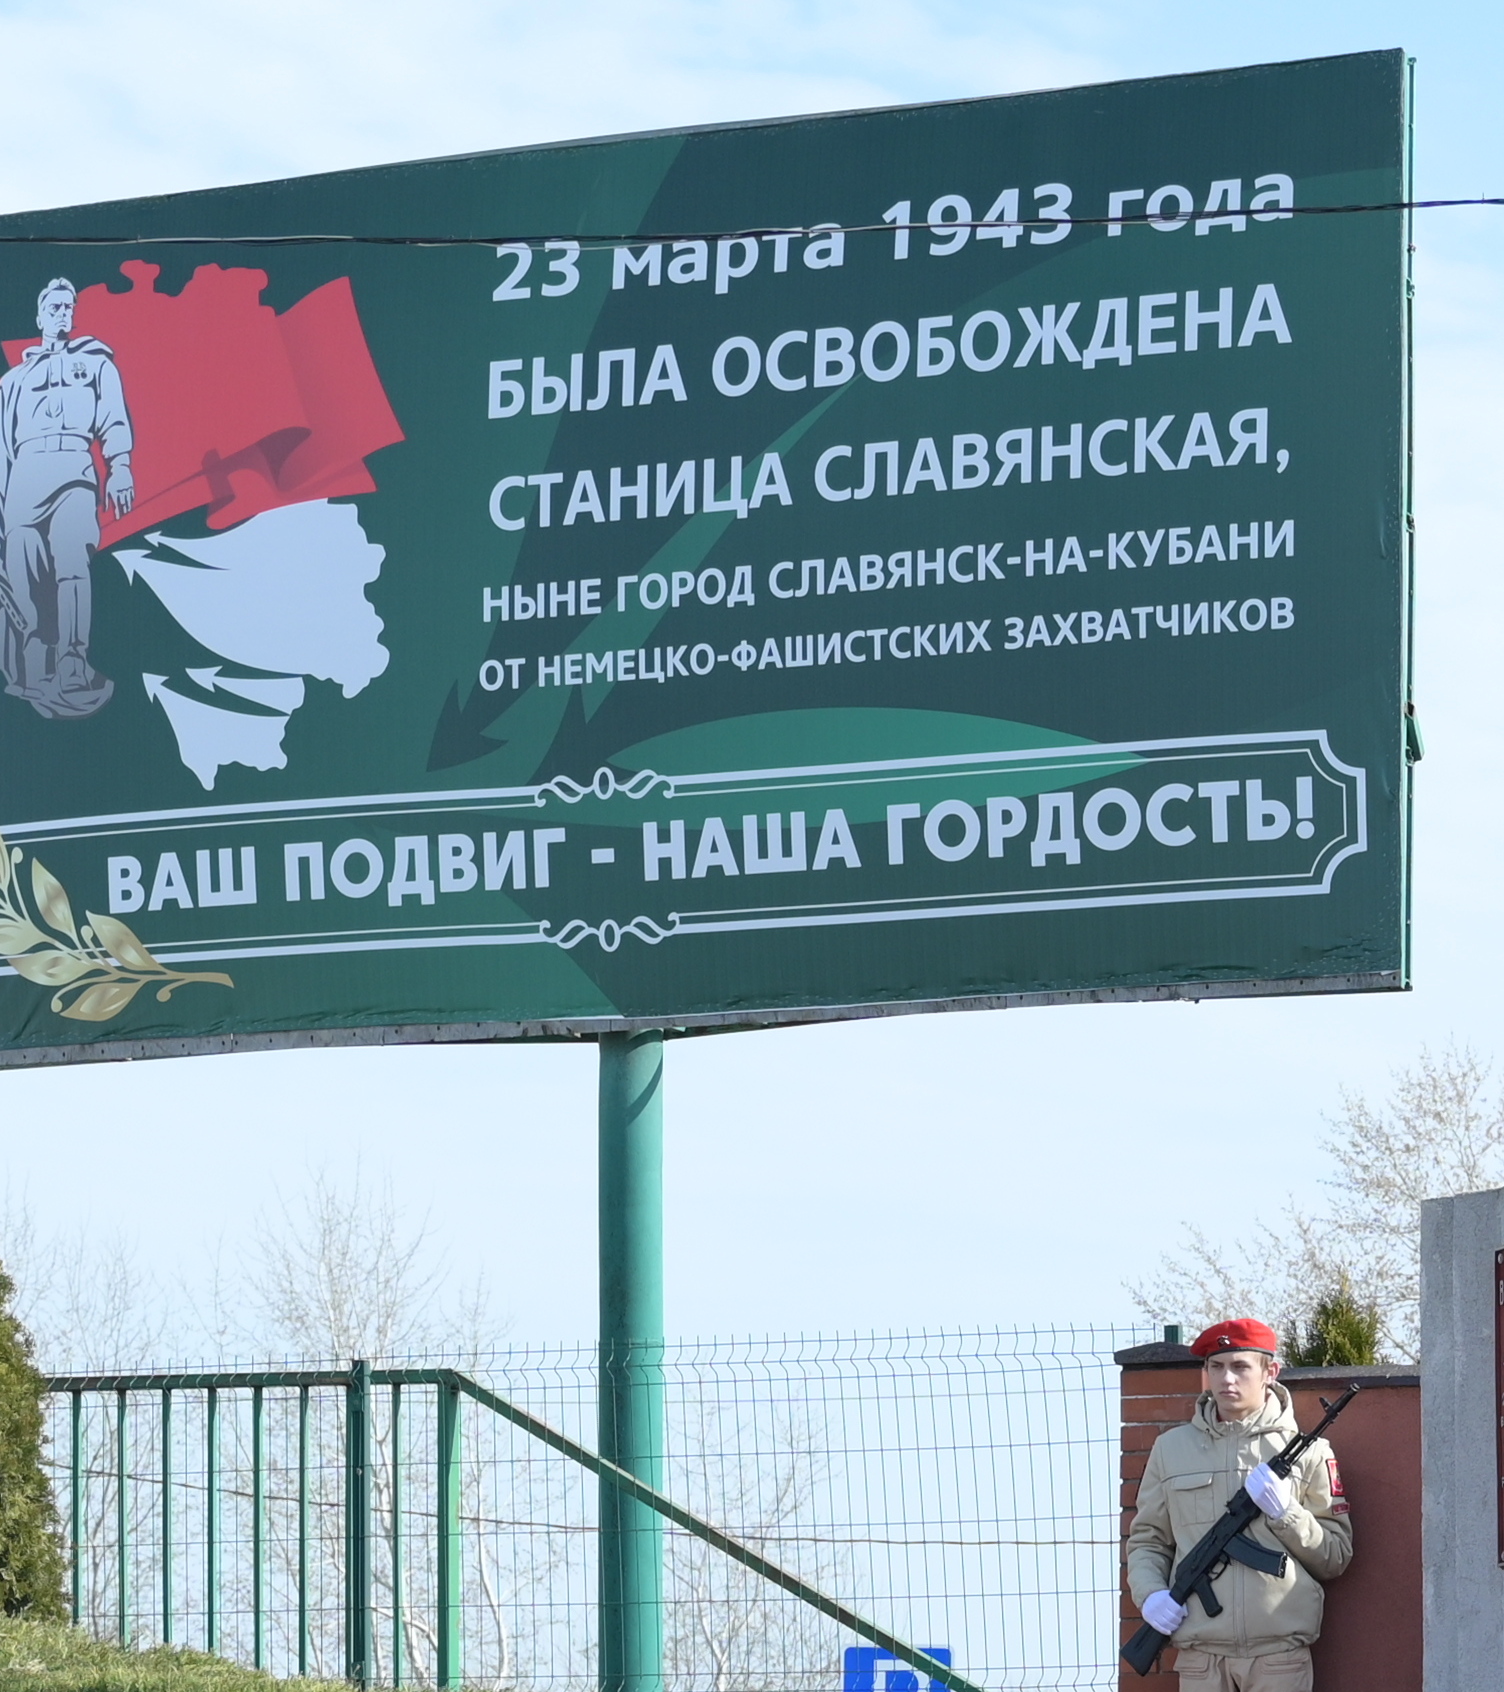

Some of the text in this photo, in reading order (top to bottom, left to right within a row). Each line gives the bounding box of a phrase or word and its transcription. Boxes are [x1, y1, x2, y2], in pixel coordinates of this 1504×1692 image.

[492, 173, 1295, 302] 23 марта 1943 года
[488, 283, 1293, 420] БЫЛА ОСВОБОЖДЕНА
[488, 407, 1292, 532] СТАНИЦА СЛАВЯНСКАЯ,
[483, 519, 1296, 623] НЫНЕ ГОРОД СЛАВЯНСК-НА-КУБАНИ
[479, 595, 1296, 692] ОТ НЕМЕЦКО-ФАШИСТСКИХ ЗАХВАТЧИКОВ
[106, 846, 258, 915] ВАШ
[283, 827, 567, 908] ПОДВИГ
[641, 808, 862, 883] НАША
[886, 776, 1316, 868] ГОРДОСТЬ!
[1500, 1280, 1504, 1305] В
